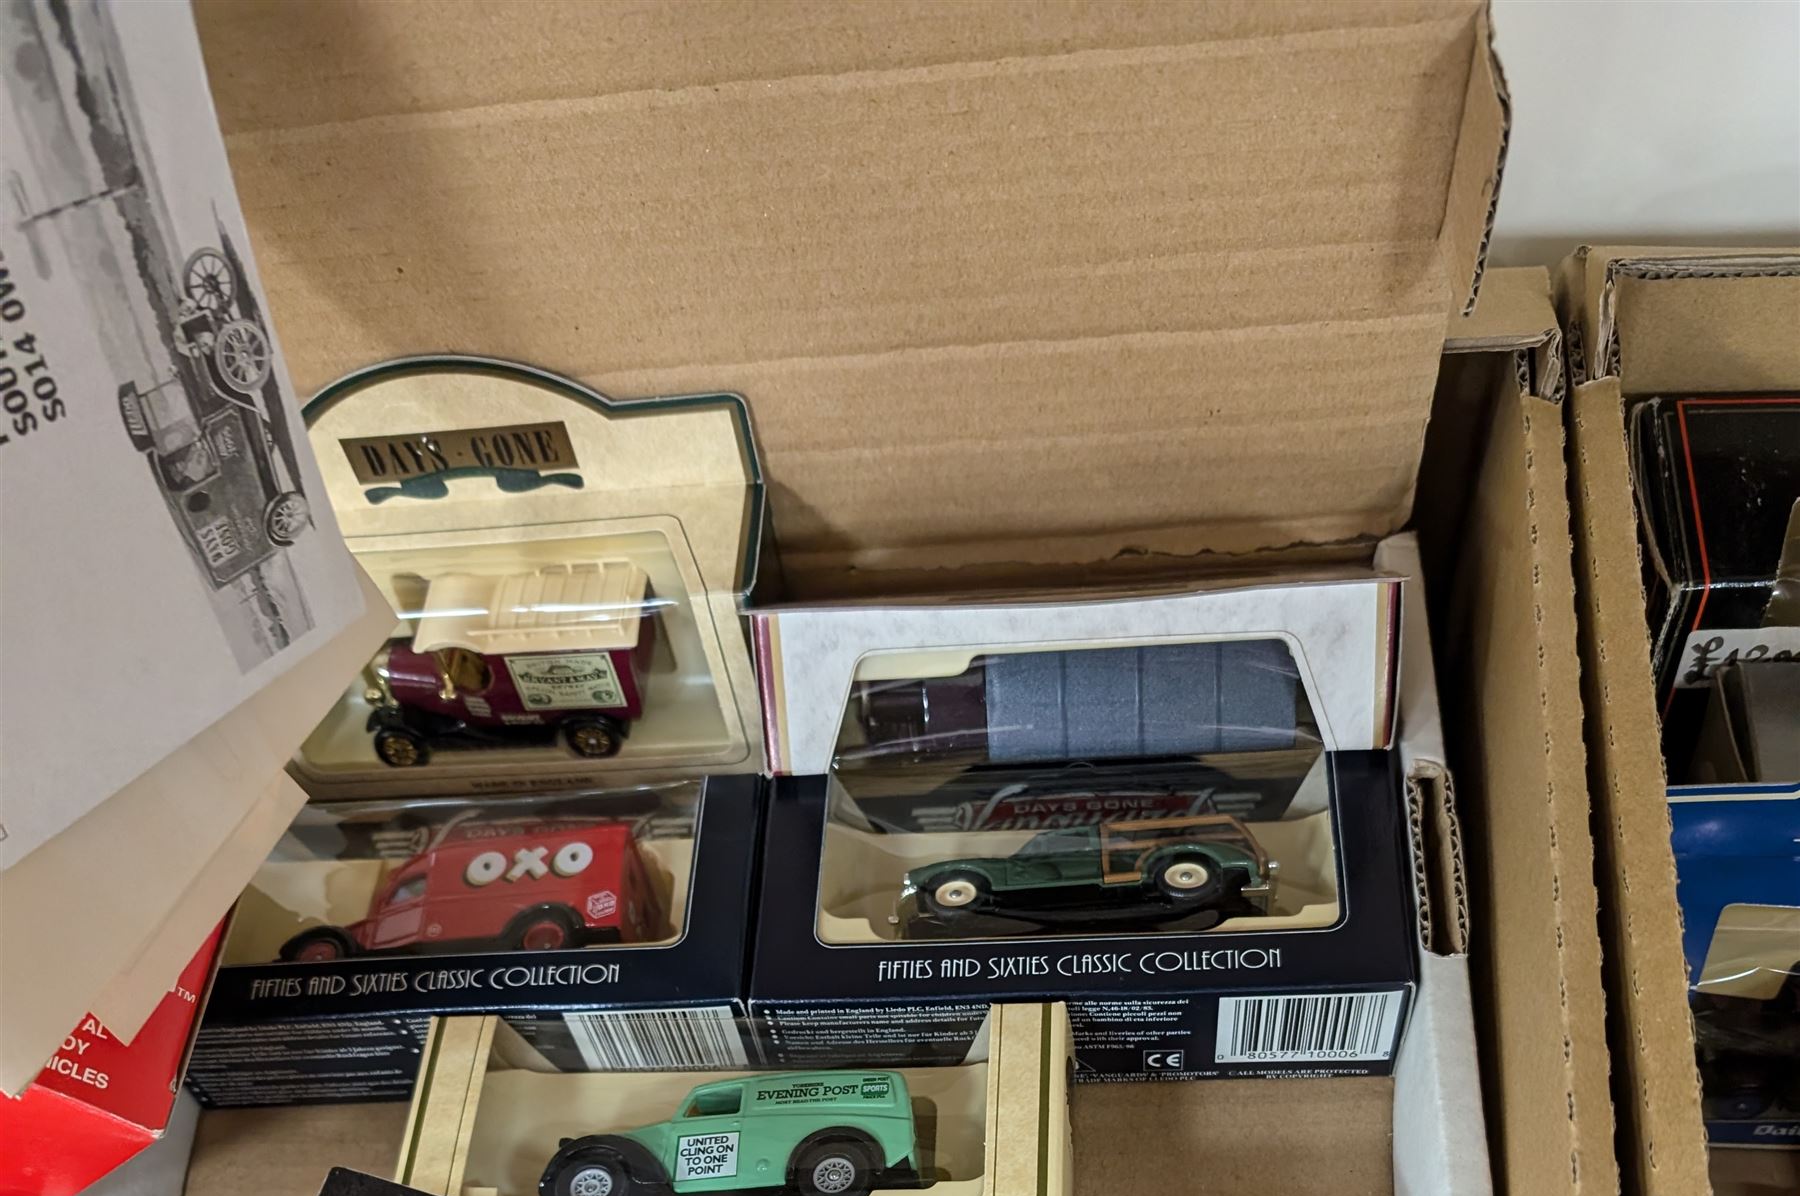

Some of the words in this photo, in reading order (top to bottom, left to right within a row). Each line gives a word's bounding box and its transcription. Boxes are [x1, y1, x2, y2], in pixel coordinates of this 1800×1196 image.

[0, 345, 38, 436] SOU
[360, 438, 450, 477] DAYS
[470, 430, 560, 469] GONE
[1013, 801, 1078, 815] DAYS
[1086, 799, 1156, 812] GONE
[465, 842, 593, 886] OXO
[878, 959, 933, 982] FIFTIES
[940, 957, 981, 978] AND
[987, 955, 1049, 980] SIXTIES
[1057, 952, 1133, 976] CLASSIC
[1139, 948, 1282, 974] COLLECTION
[251, 978, 303, 1000] FIFTIES
[308, 975, 346, 996] AND
[350, 972, 409, 997] SIXTIES
[414, 969, 485, 993] CLASSIC
[490, 964, 620, 990] COLLECTION
[810, 1008, 836, 1016] printed
[1147, 1053, 1180, 1067] CE
[1247, 1051, 1298, 1059] 80577
[1308, 1050, 1358, 1059] 10006
[756, 1086, 820, 1101] EVENING
[822, 1084, 859, 1096] POST
[863, 1084, 888, 1093] SPORTS
[687, 1136, 729, 1147] UNITED
[680, 1146, 714, 1157] CLING
[716, 1144, 734, 1153] ON
[685, 1157, 701, 1166] TO
[704, 1154, 728, 1164] ONE
[688, 1164, 724, 1176] POINT
